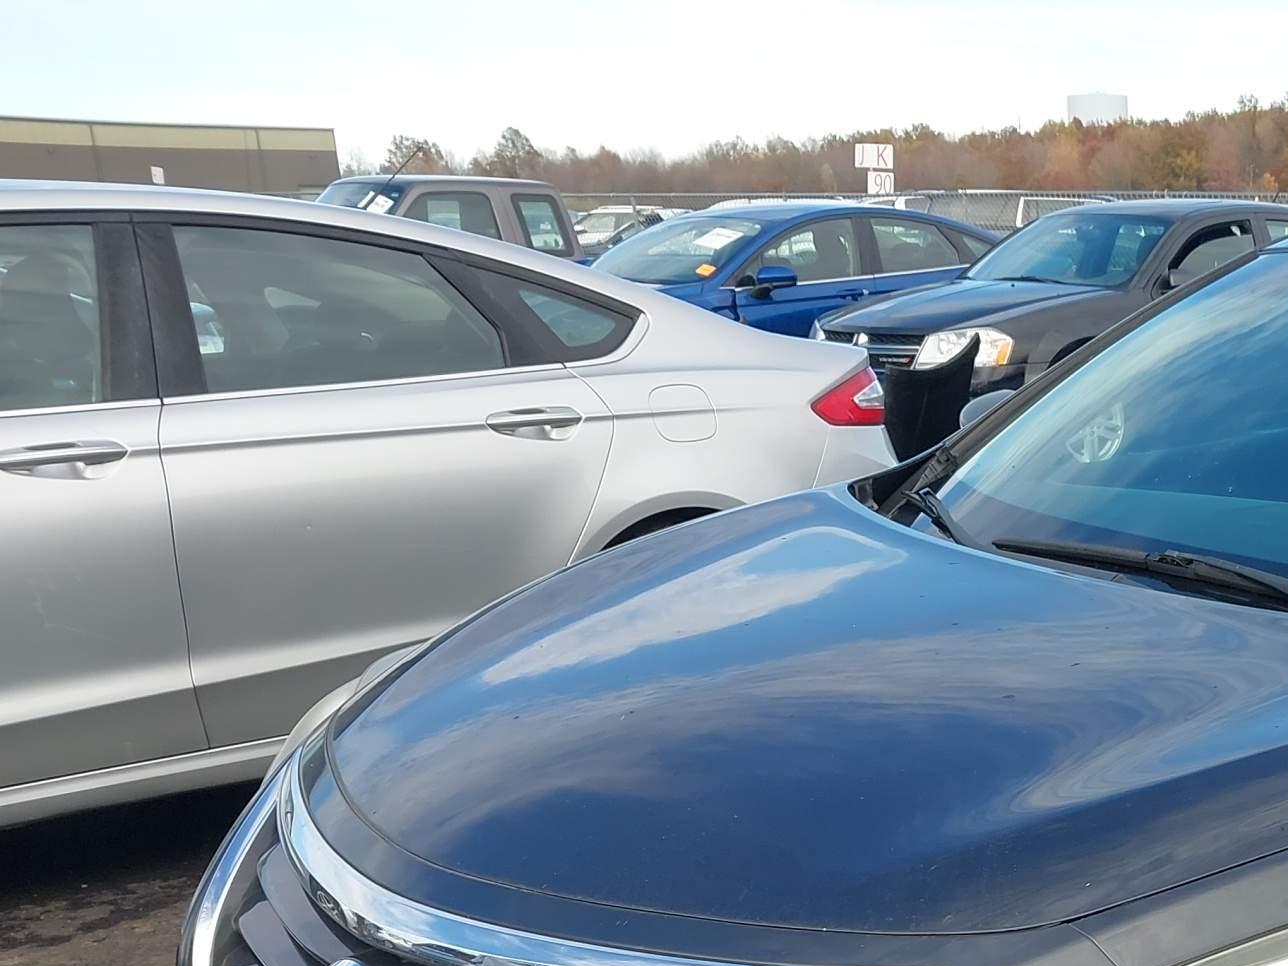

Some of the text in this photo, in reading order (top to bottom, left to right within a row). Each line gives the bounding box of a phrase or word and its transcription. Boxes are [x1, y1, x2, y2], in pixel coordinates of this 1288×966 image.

[858, 145, 888, 167] J K
[874, 174, 892, 193] 90
